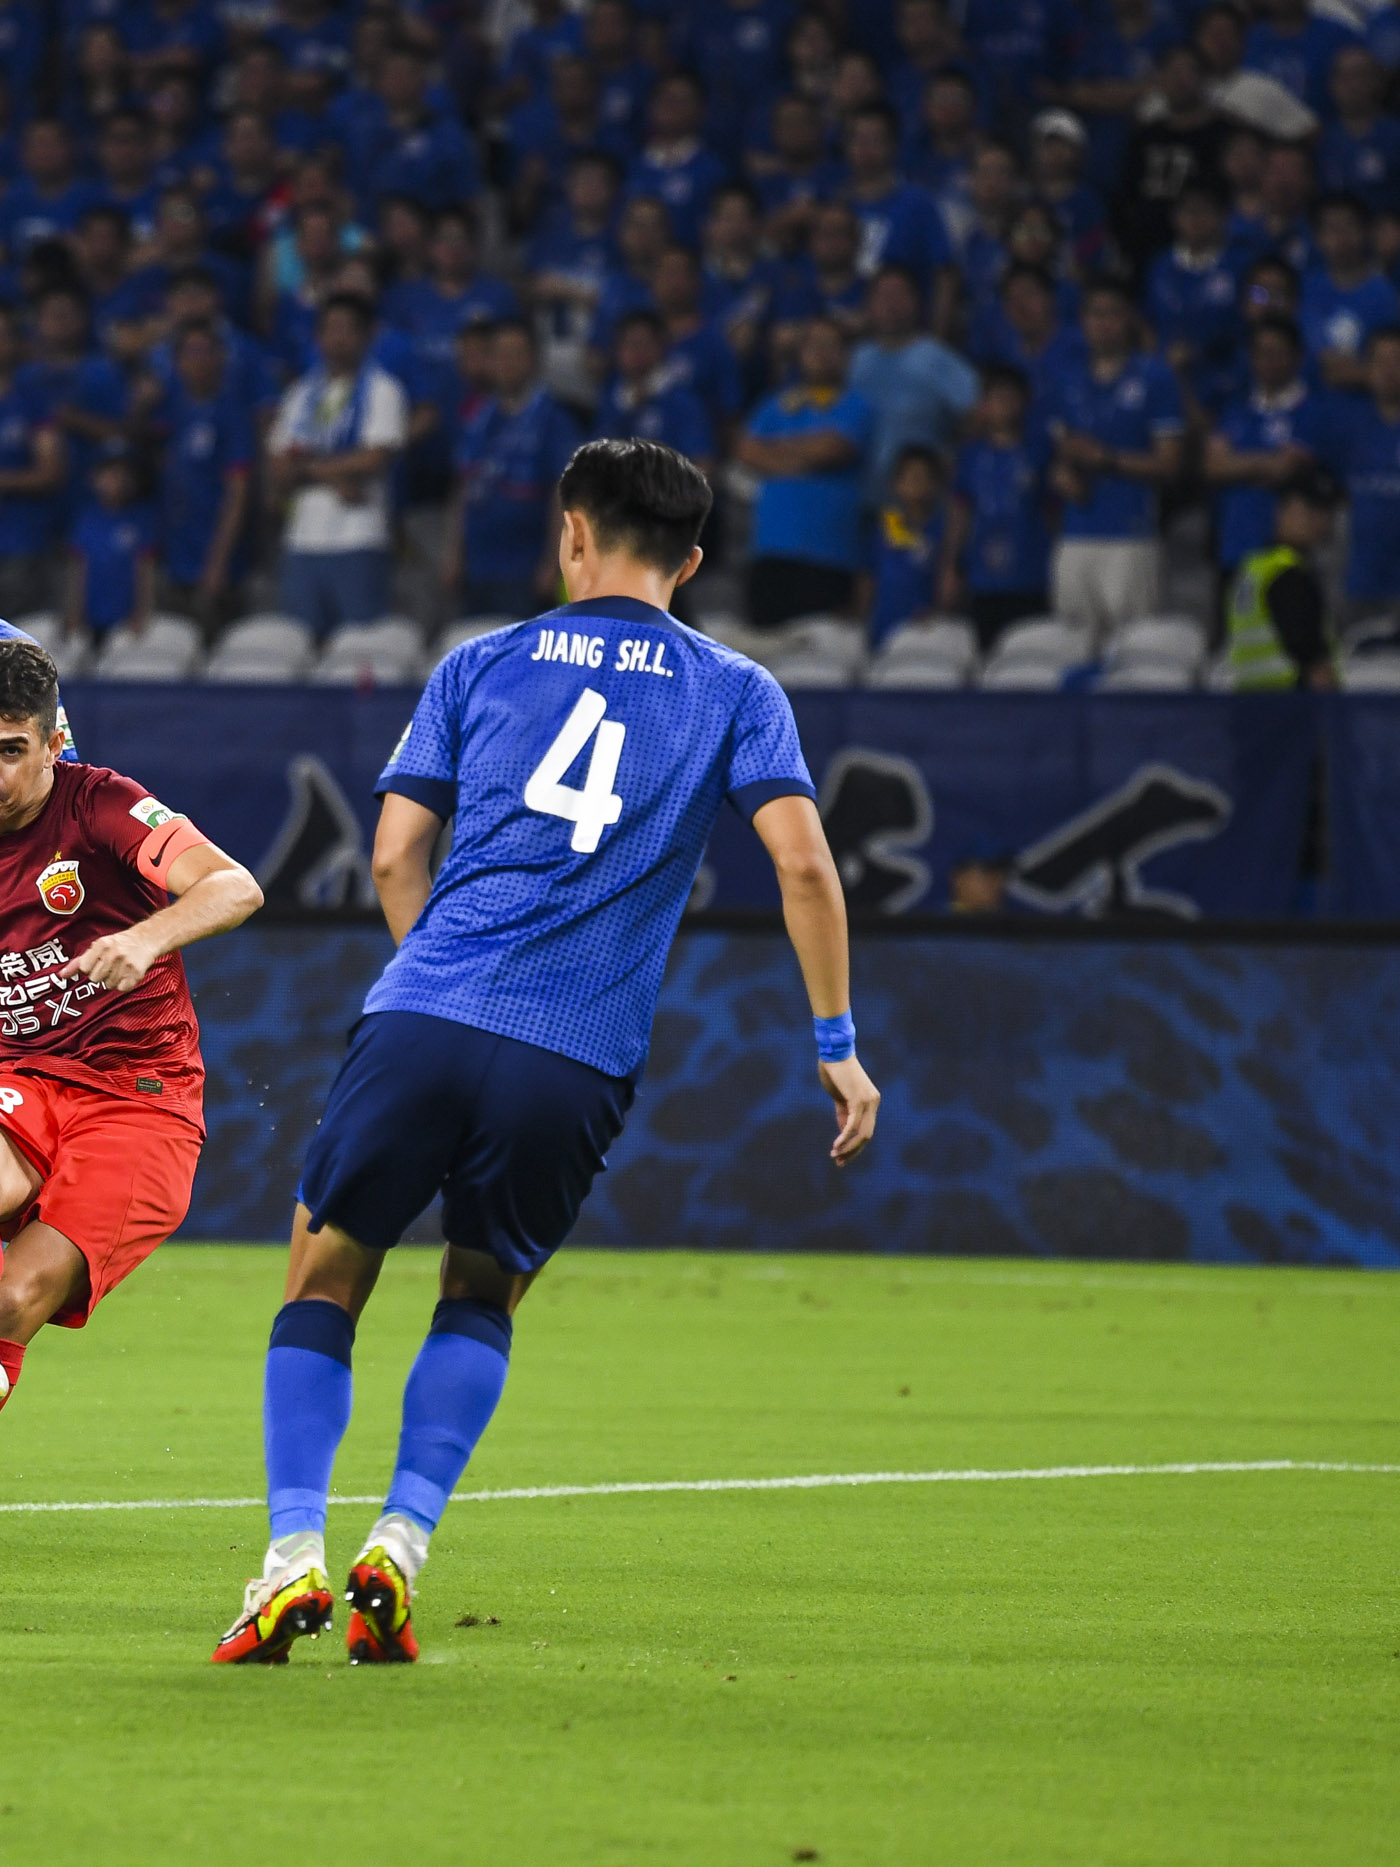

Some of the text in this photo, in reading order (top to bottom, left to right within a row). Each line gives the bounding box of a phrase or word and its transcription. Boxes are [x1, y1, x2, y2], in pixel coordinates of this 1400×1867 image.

[531, 629, 674, 677] JIANG SH.L.
[524, 687, 626, 854] 4
[0, 938, 69, 982] 荣威
[74, 981, 107, 1001] DM
